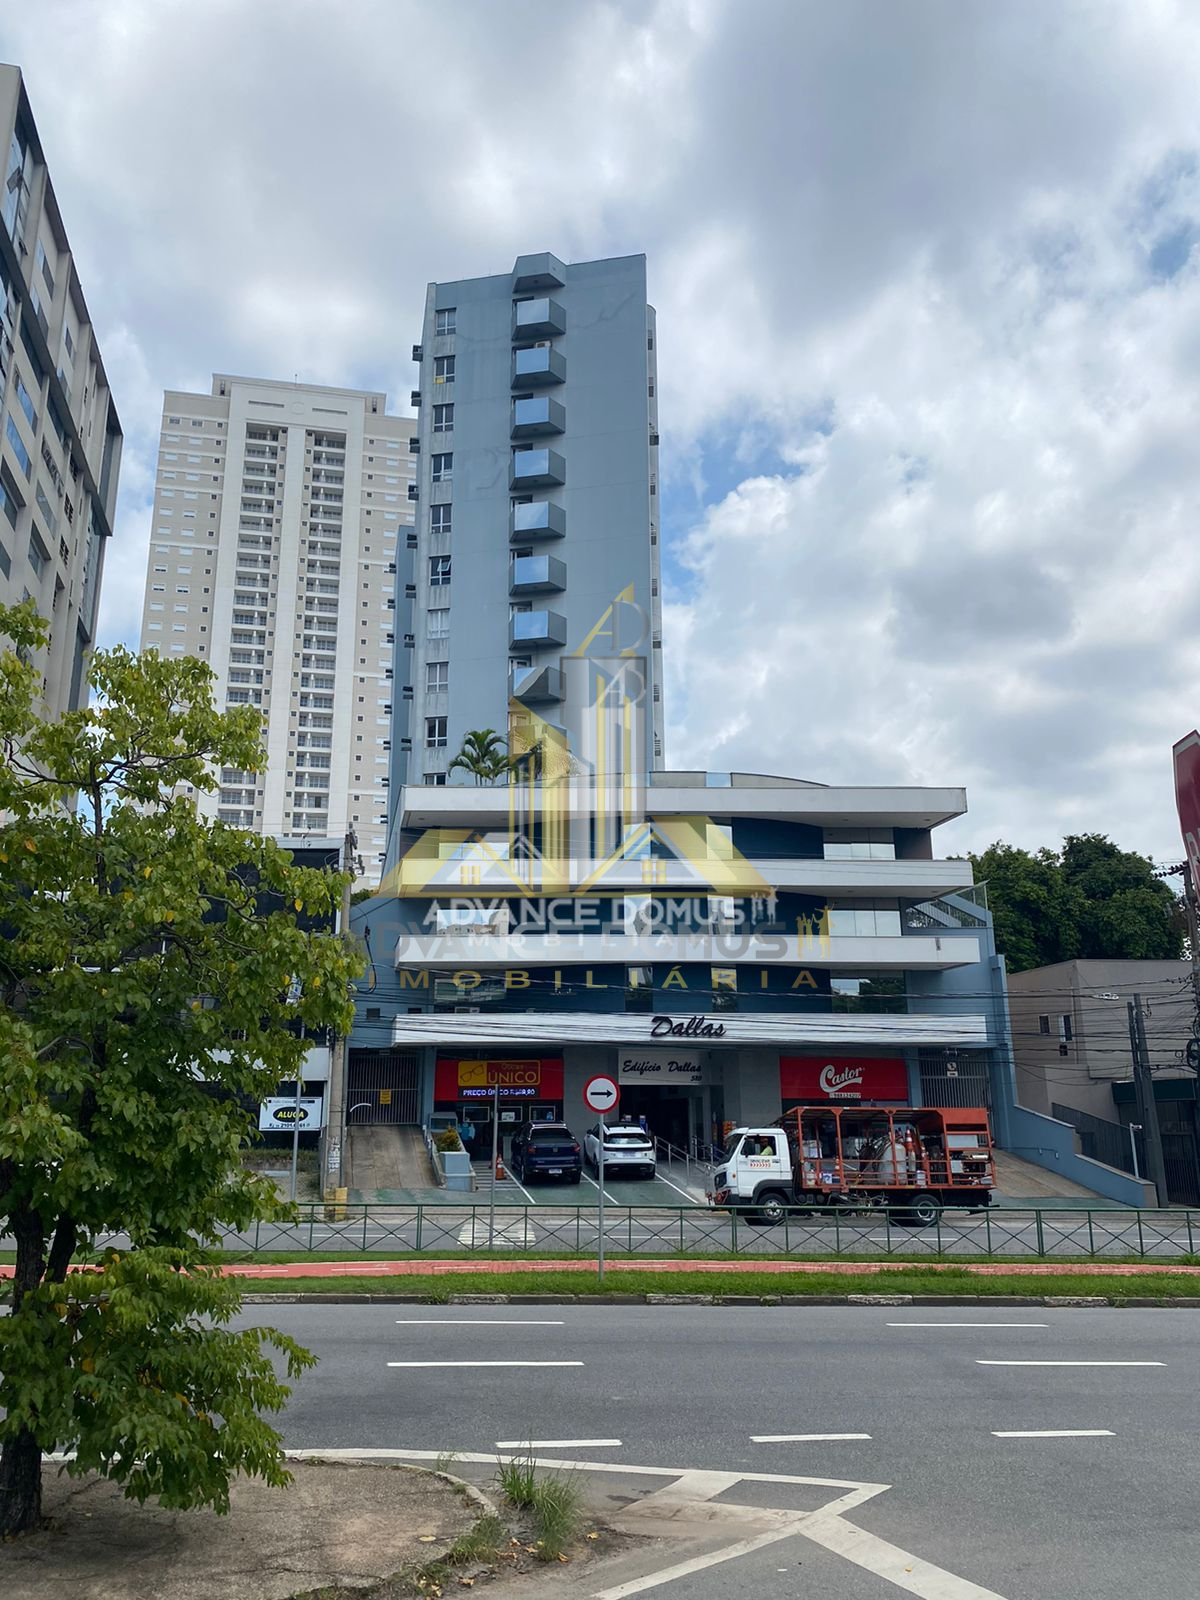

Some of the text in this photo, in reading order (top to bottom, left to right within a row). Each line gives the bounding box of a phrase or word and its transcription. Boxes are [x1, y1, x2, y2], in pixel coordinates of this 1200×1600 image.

[651, 1015, 727, 1037] Dallas
[622, 1060, 702, 1075] Edifício Dallas
[820, 1064, 863, 1093] Castor
[487, 1088, 509, 1096] ÚNCO
